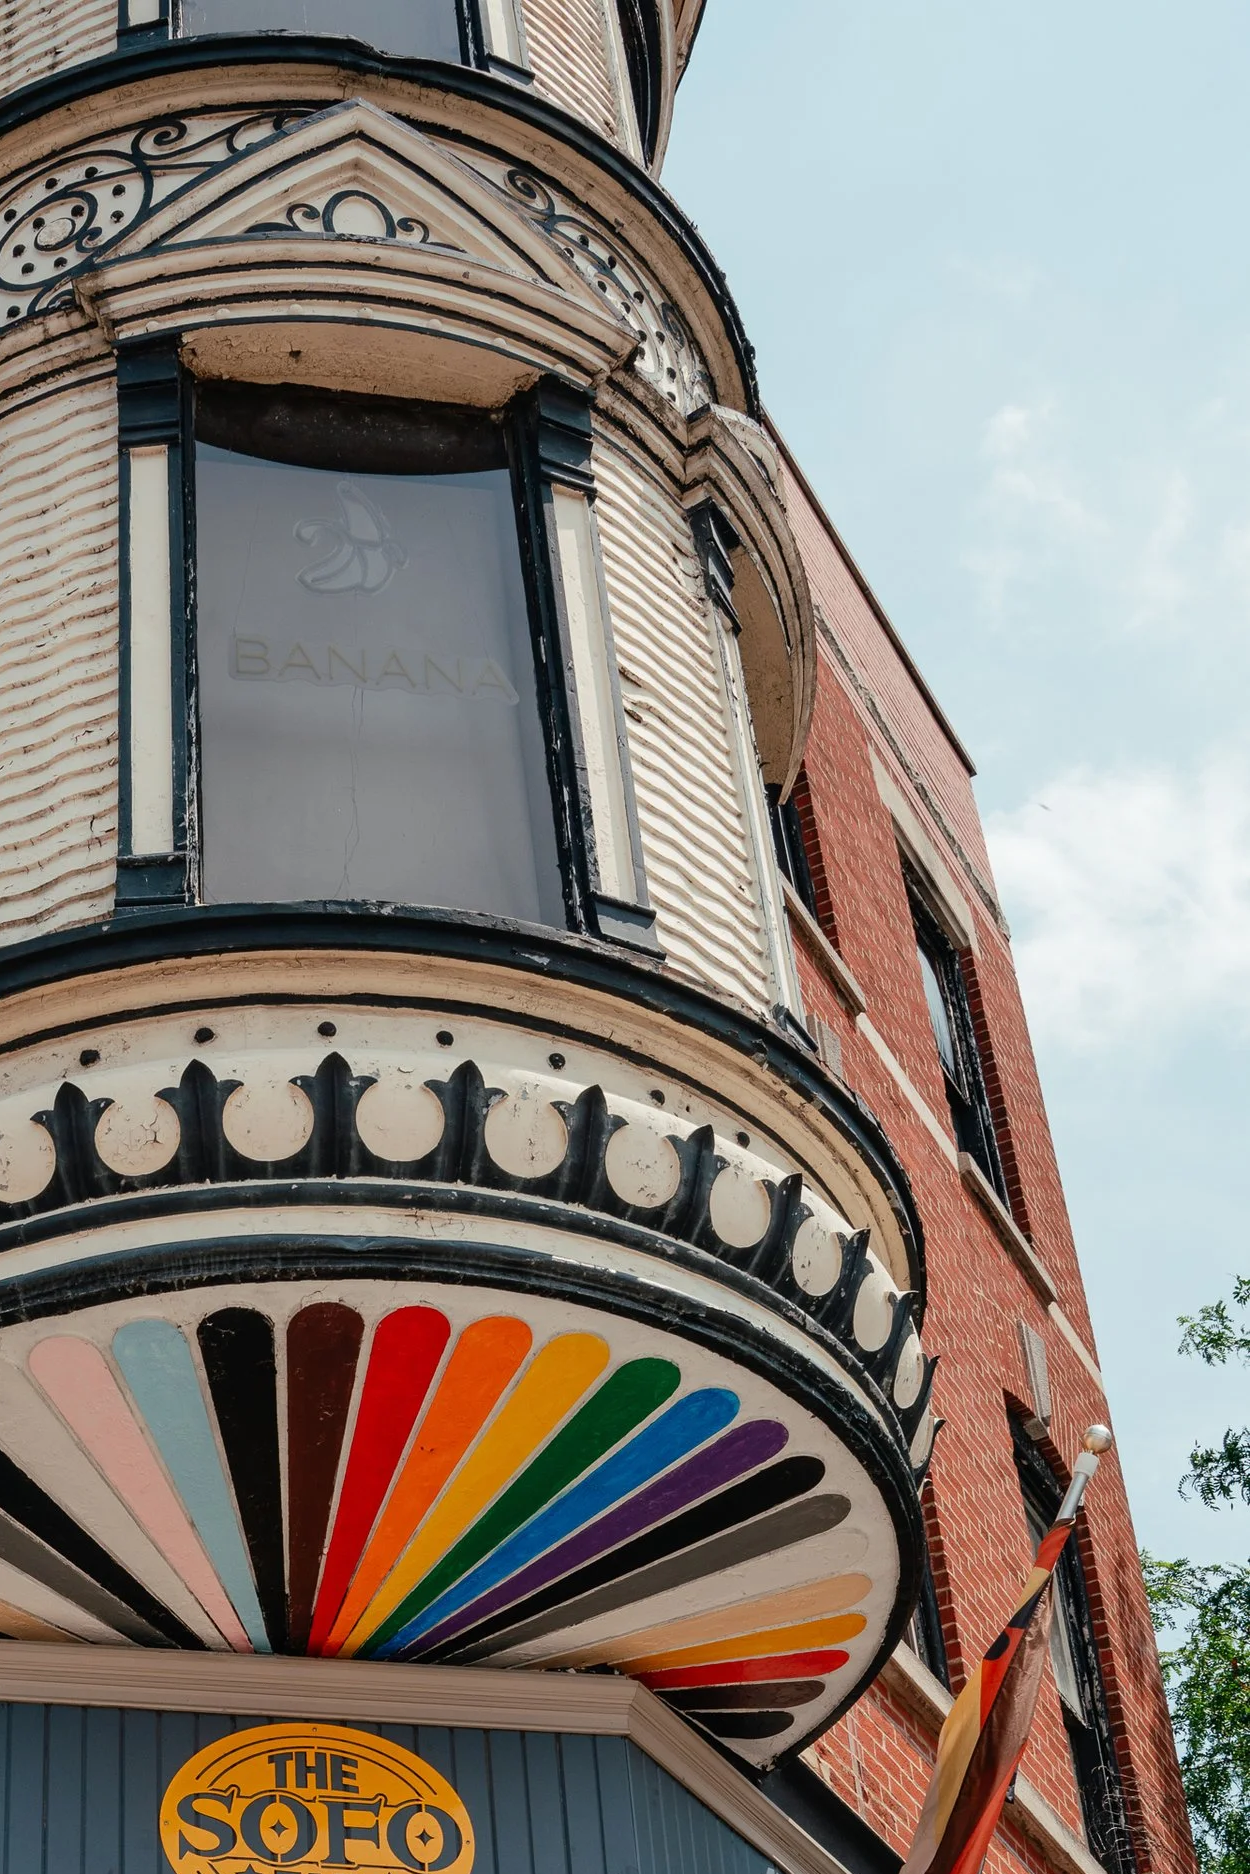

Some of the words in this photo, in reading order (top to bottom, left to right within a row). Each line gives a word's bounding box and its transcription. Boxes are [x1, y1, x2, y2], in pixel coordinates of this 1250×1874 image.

[234, 638, 514, 700] BANANA
[267, 1751, 360, 1793] THE
[176, 1791, 463, 1873] SOFO
